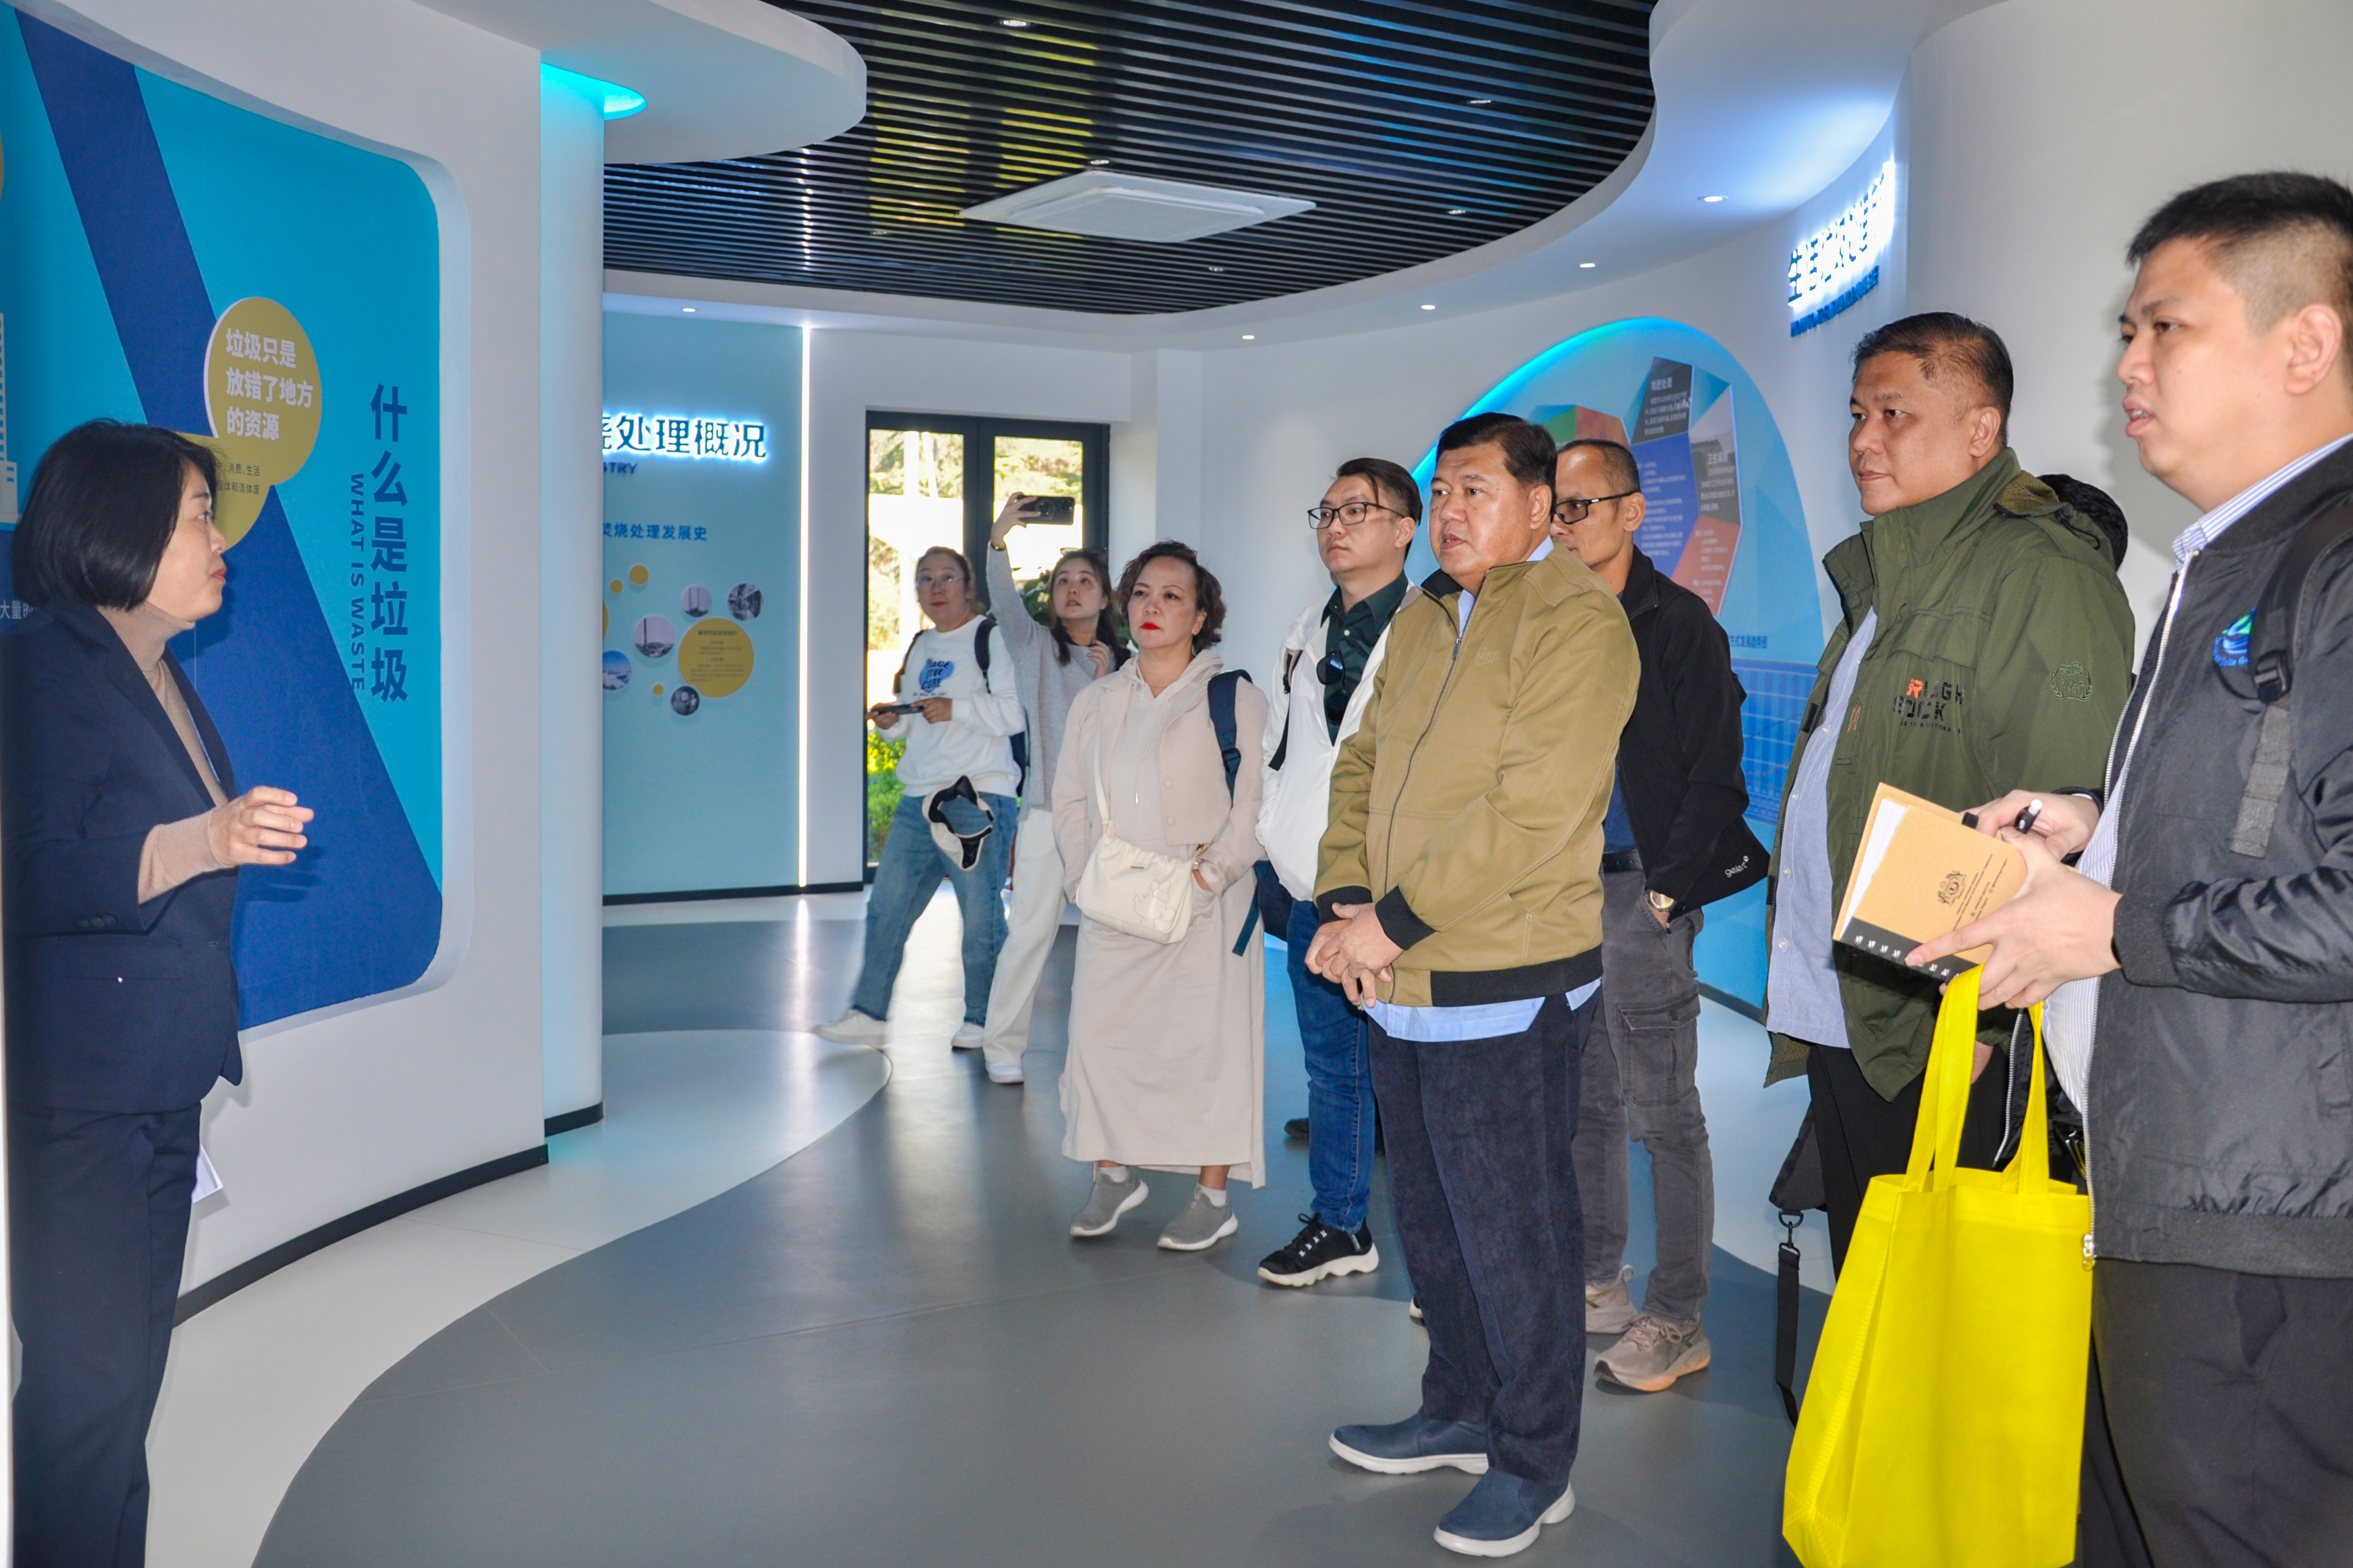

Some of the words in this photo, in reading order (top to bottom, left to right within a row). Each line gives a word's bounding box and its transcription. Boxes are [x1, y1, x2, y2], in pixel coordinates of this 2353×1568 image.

[226, 328, 296, 368] 垃圾只是
[226, 367, 314, 408] 放错了地方
[226, 406, 280, 440] 的资源
[603, 416, 767, 458] 处理概况
[351, 473, 364, 552] WHAT
[370, 383, 409, 702] 什么是垃圾
[351, 562, 364, 587] IS
[351, 597, 364, 691] WASTE
